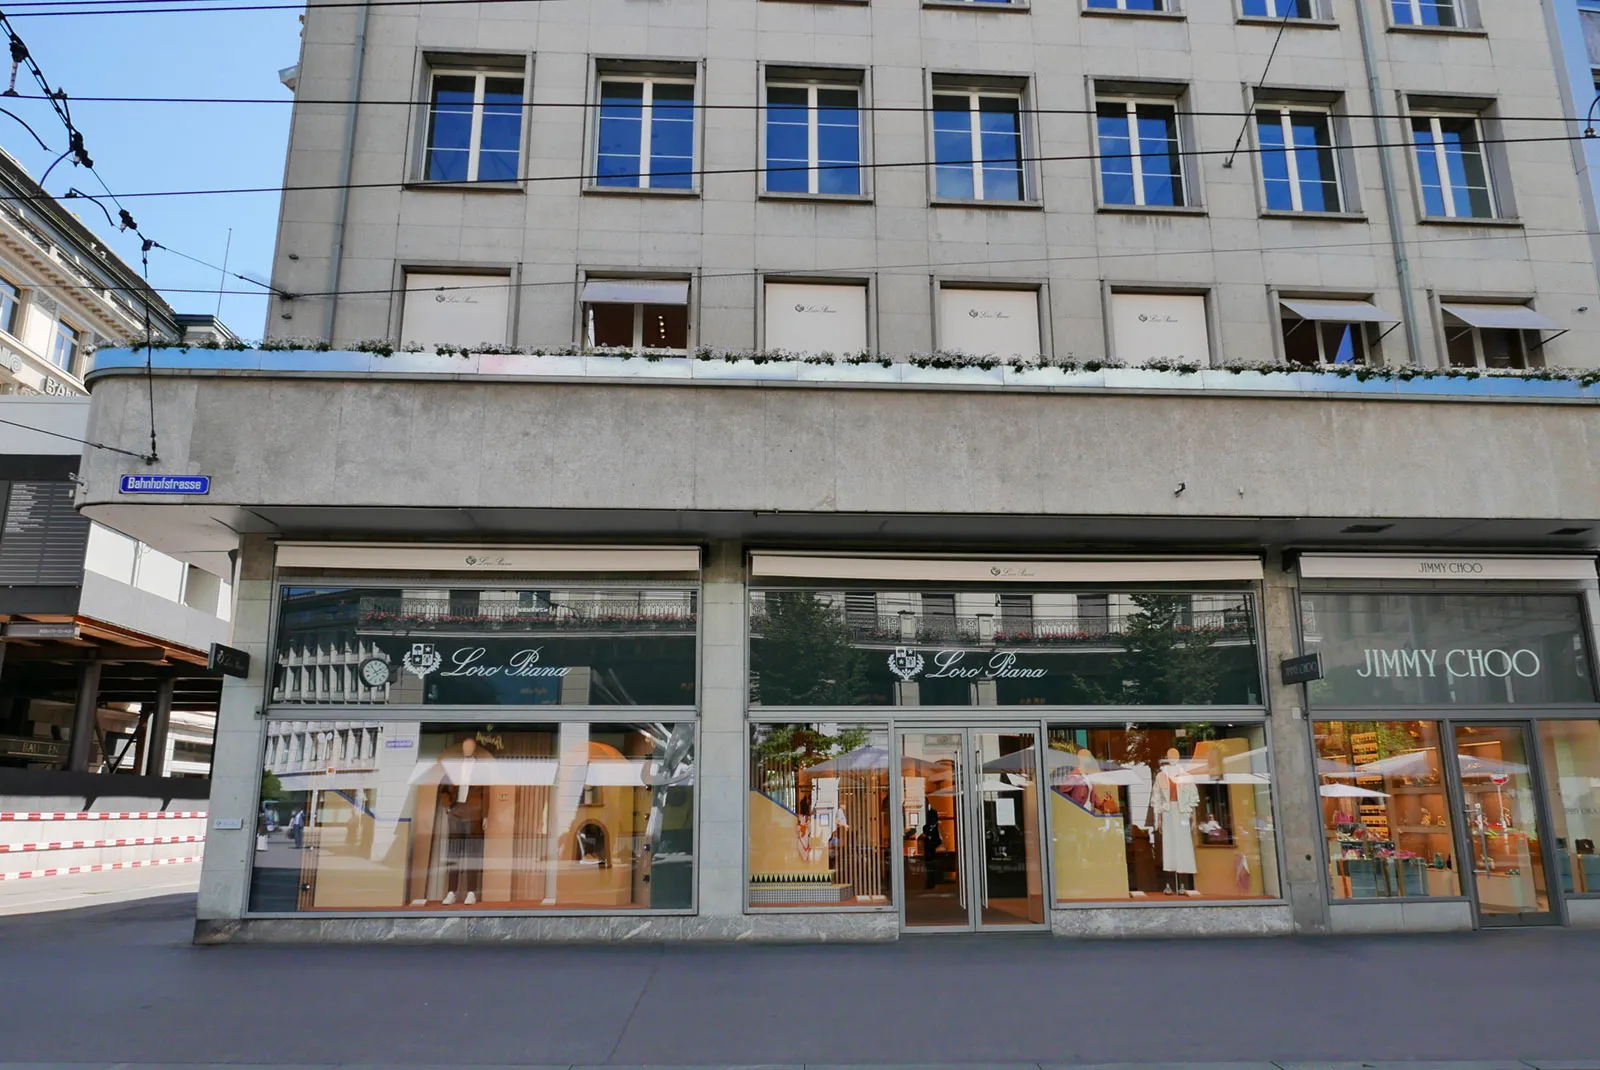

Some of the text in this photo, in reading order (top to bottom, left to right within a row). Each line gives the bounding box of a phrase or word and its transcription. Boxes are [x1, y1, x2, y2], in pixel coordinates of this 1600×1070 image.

[128, 477, 202, 489] Bahnhofstrasse
[1419, 562, 1483, 574] JIMMY CHOO
[440, 645, 572, 677] Loro Piana
[924, 648, 1048, 679] Loro Piana
[1356, 649, 1540, 678] JIMMY CHOO
